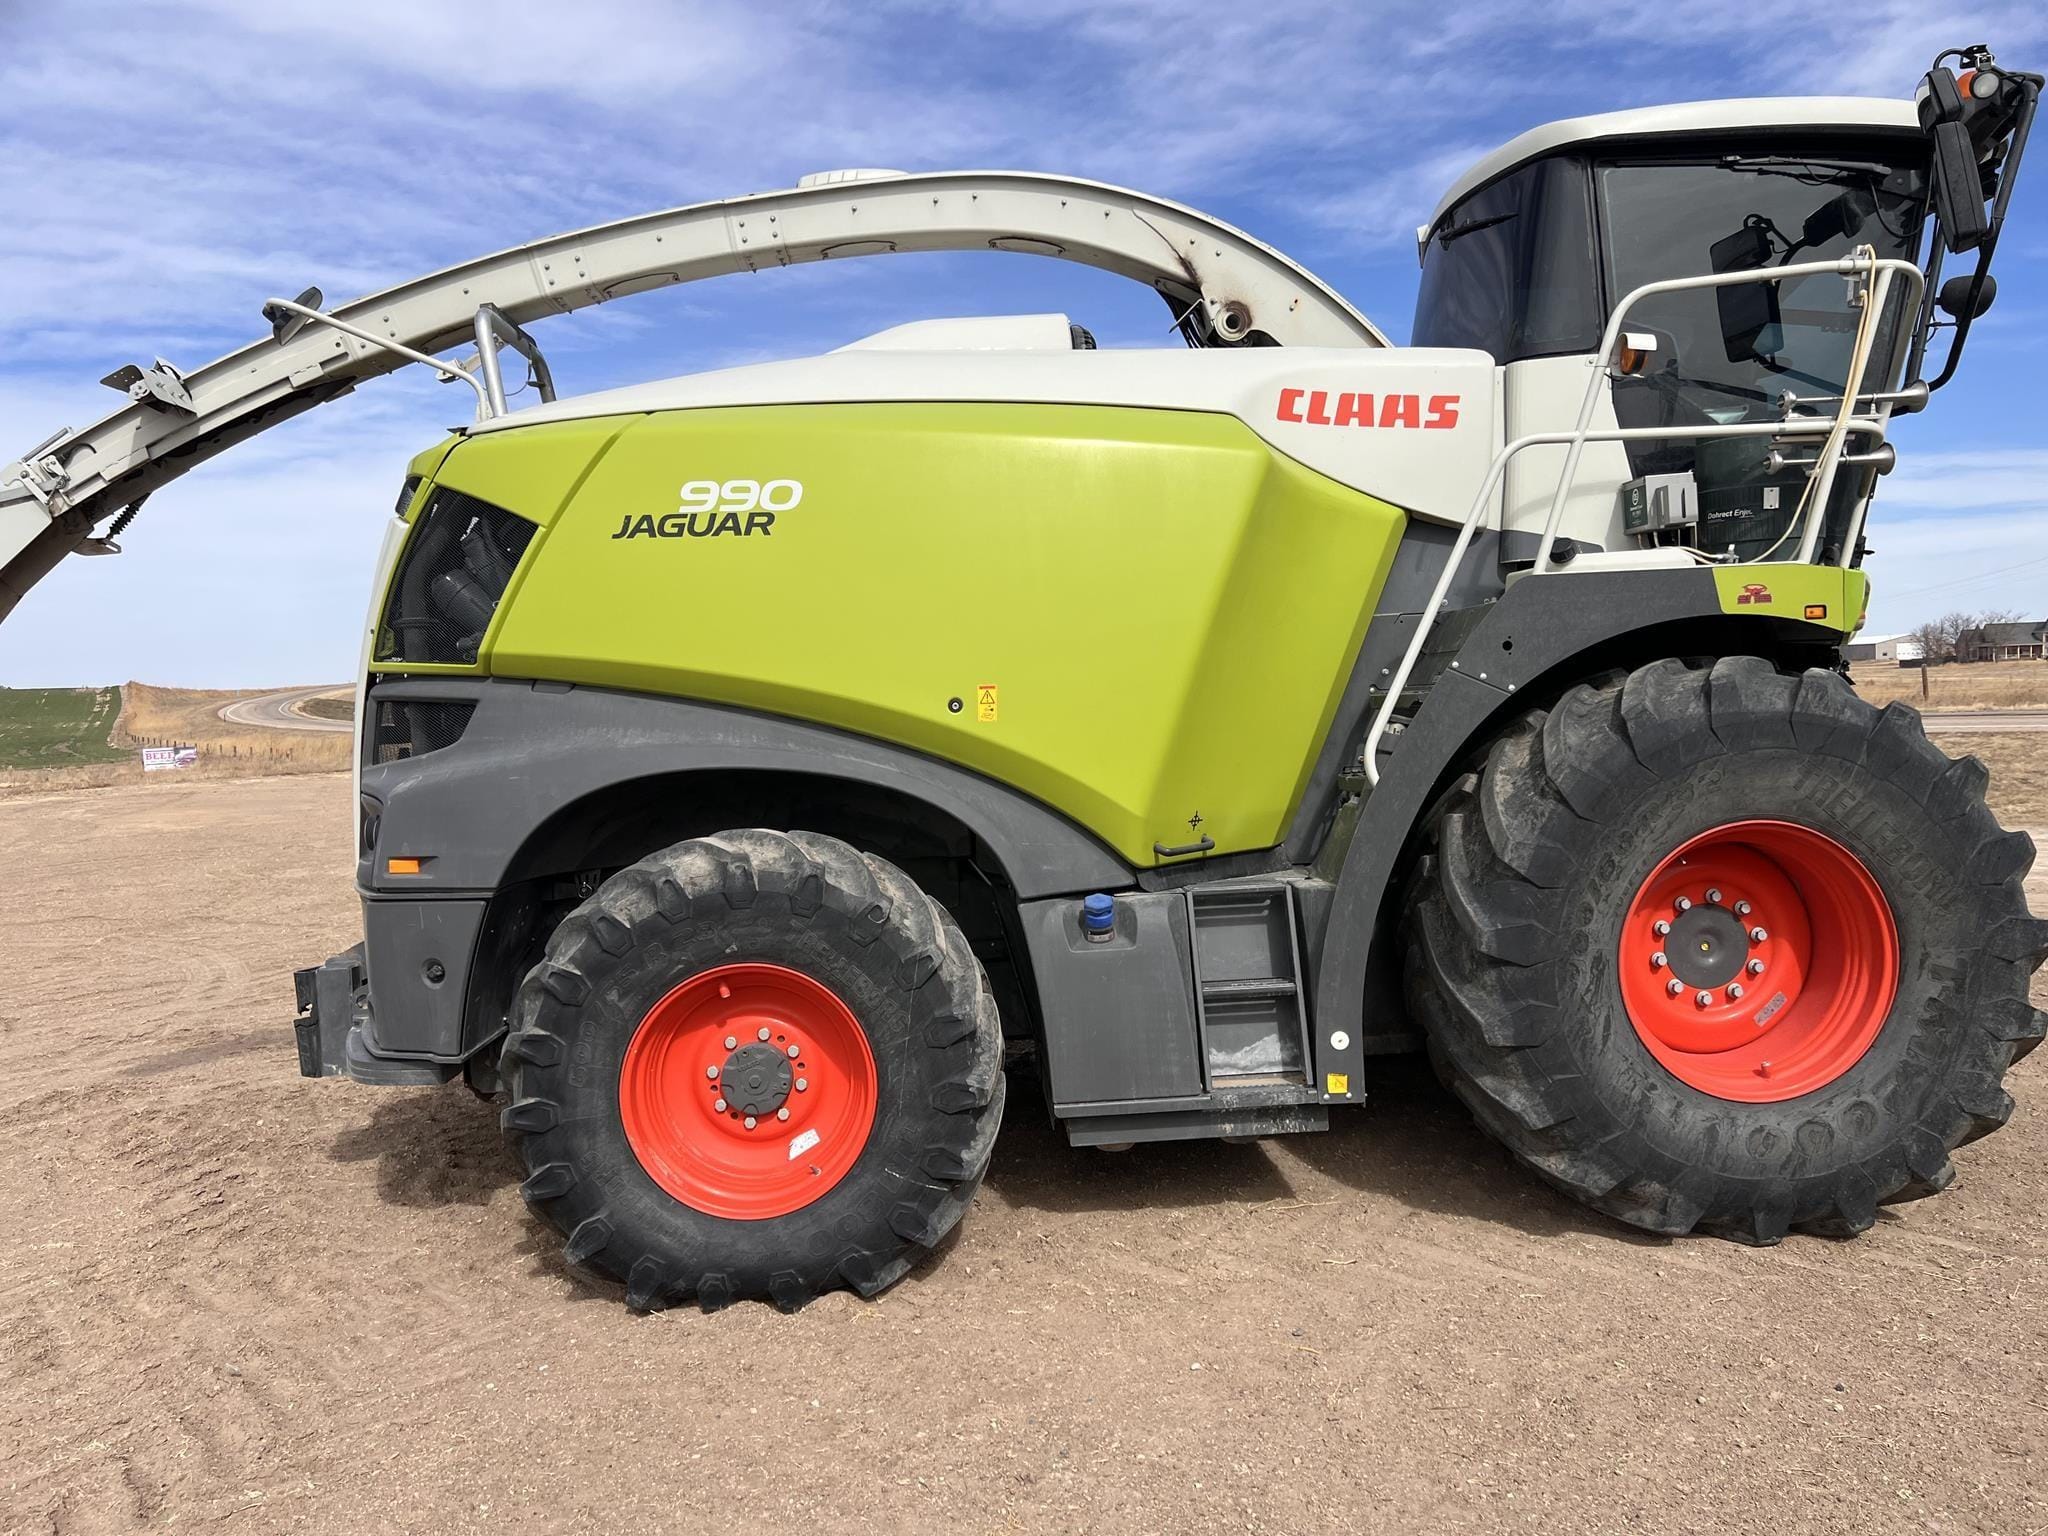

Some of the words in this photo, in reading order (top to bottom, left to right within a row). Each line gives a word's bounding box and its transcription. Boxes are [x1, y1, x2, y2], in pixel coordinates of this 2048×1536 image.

[1277, 388, 1460, 429] CLAAS
[679, 479, 803, 512] 990
[612, 512, 775, 539] JAGUAR
